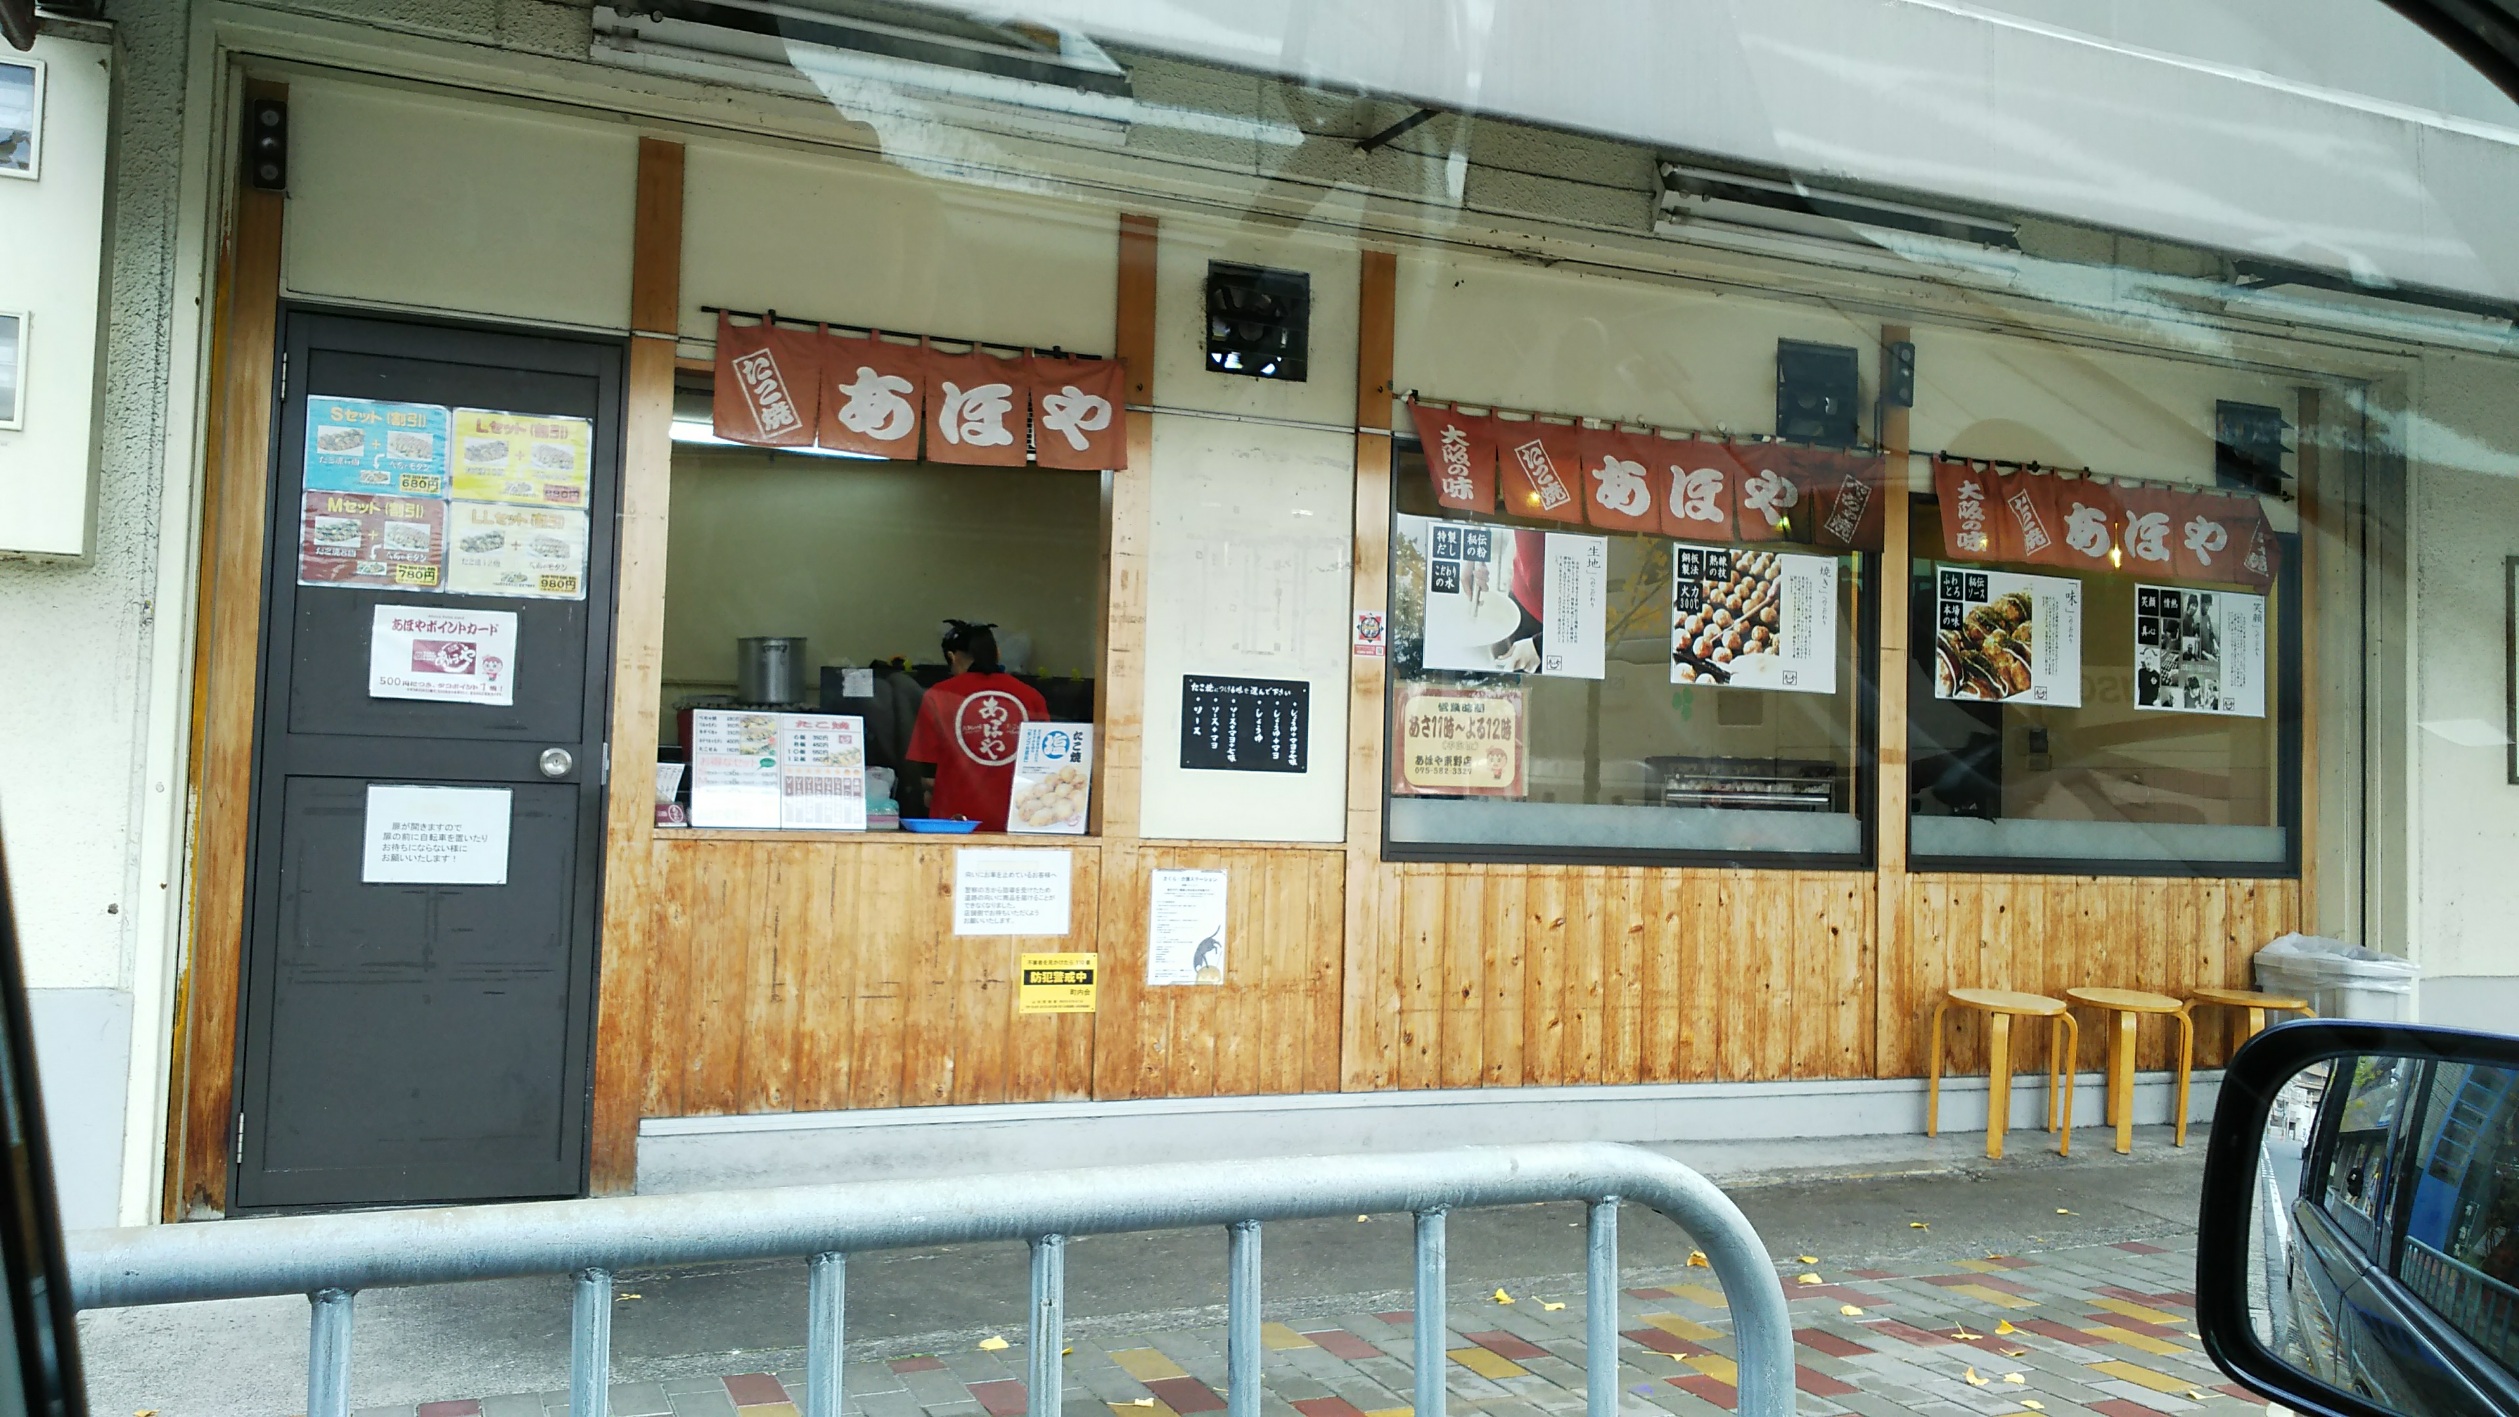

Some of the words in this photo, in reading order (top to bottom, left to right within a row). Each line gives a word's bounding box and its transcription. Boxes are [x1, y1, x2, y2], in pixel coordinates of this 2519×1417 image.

[742, 356, 795, 432] たこ焼
[838, 366, 1112, 451] あほや
[1440, 423, 1474, 501] 大阪の味
[1521, 445, 1566, 507] たこ焼
[402, 480, 439, 490] 680円
[1591, 454, 1799, 525] あほや
[1956, 479, 1987, 552] 大阪の味
[2014, 496, 2047, 550] たこ焼
[1437, 530, 1457, 544] 特製
[1467, 532, 1487, 546] 秘伝
[2063, 501, 2228, 566] あほや
[1437, 544, 1456, 556] だし
[1467, 546, 1487, 559] の粉
[399, 570, 435, 581] 780円
[1435, 565, 1457, 577] こだわり
[1682, 564, 1699, 576] 製法
[1709, 567, 1728, 579] の技
[541, 580, 576, 590] 980円
[1435, 577, 1455, 589] の水
[1943, 573, 1958, 586] ふわ
[1968, 575, 1985, 588] 秘伝
[1680, 584, 1699, 599] 火力
[1946, 586, 1960, 597] とろ
[1968, 587, 1985, 599] ソース
[2141, 595, 2156, 608] 笑顔
[2163, 597, 2179, 609] 情熱
[1943, 604, 1960, 616] 本場
[391, 619, 499, 636] あほやポイントカード
[1943, 616, 1960, 628] の味
[2141, 624, 2156, 637] 真心
[795, 720, 850, 730] たこ焼
[979, 695, 1008, 760] あほや
[1070, 731, 1083, 763] たこ焼
[391, 822, 463, 832] 扉が開きますので
[382, 833, 488, 843] 扉の前に自転車を置いたり
[382, 844, 467, 853] お待ちにならない様に
[1029, 971, 1088, 984] 防犯警戒中
